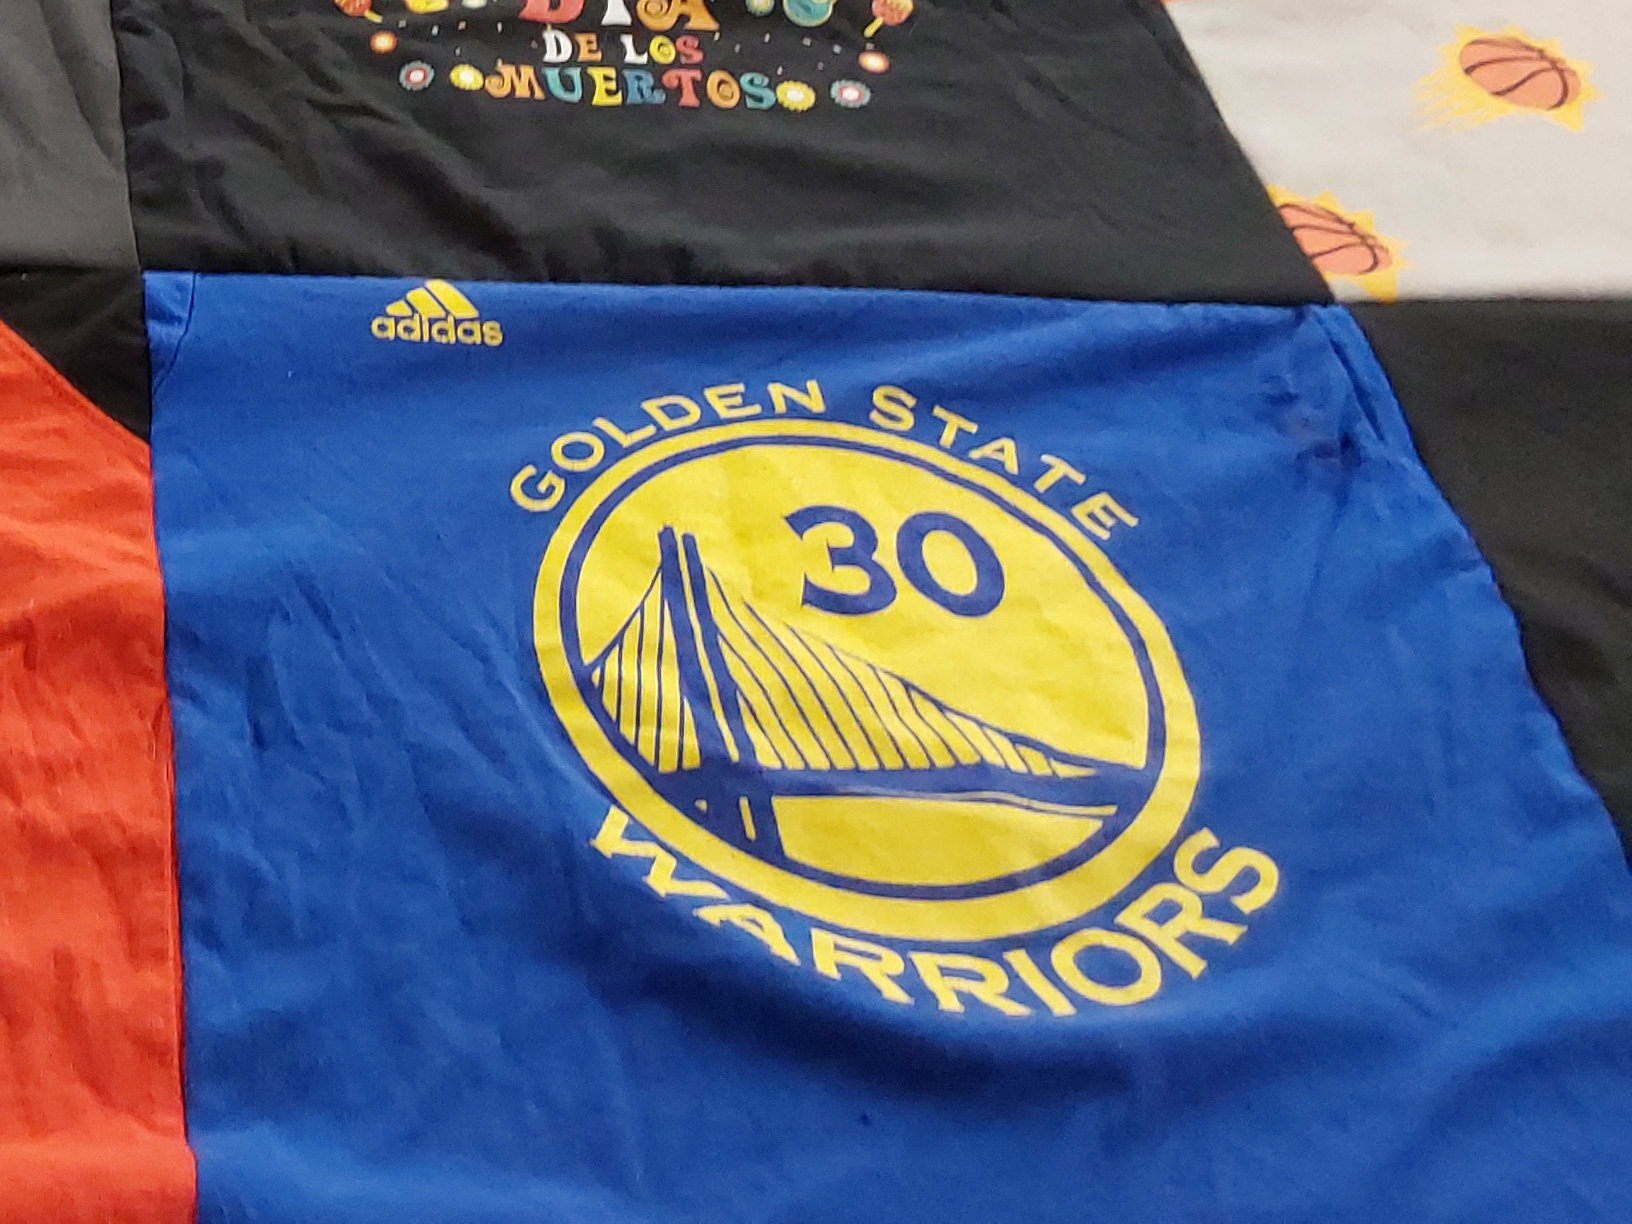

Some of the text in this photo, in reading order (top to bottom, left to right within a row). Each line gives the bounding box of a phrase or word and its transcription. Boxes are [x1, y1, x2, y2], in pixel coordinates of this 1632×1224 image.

[483, 63, 777, 109] MUERTOS
[541, 29, 705, 65] DE LOS
[370, 313, 504, 347] adidas
[509, 380, 1140, 542] GOLDEN STATE
[784, 504, 1007, 618] 30
[589, 804, 1281, 1019] WARRIORS
